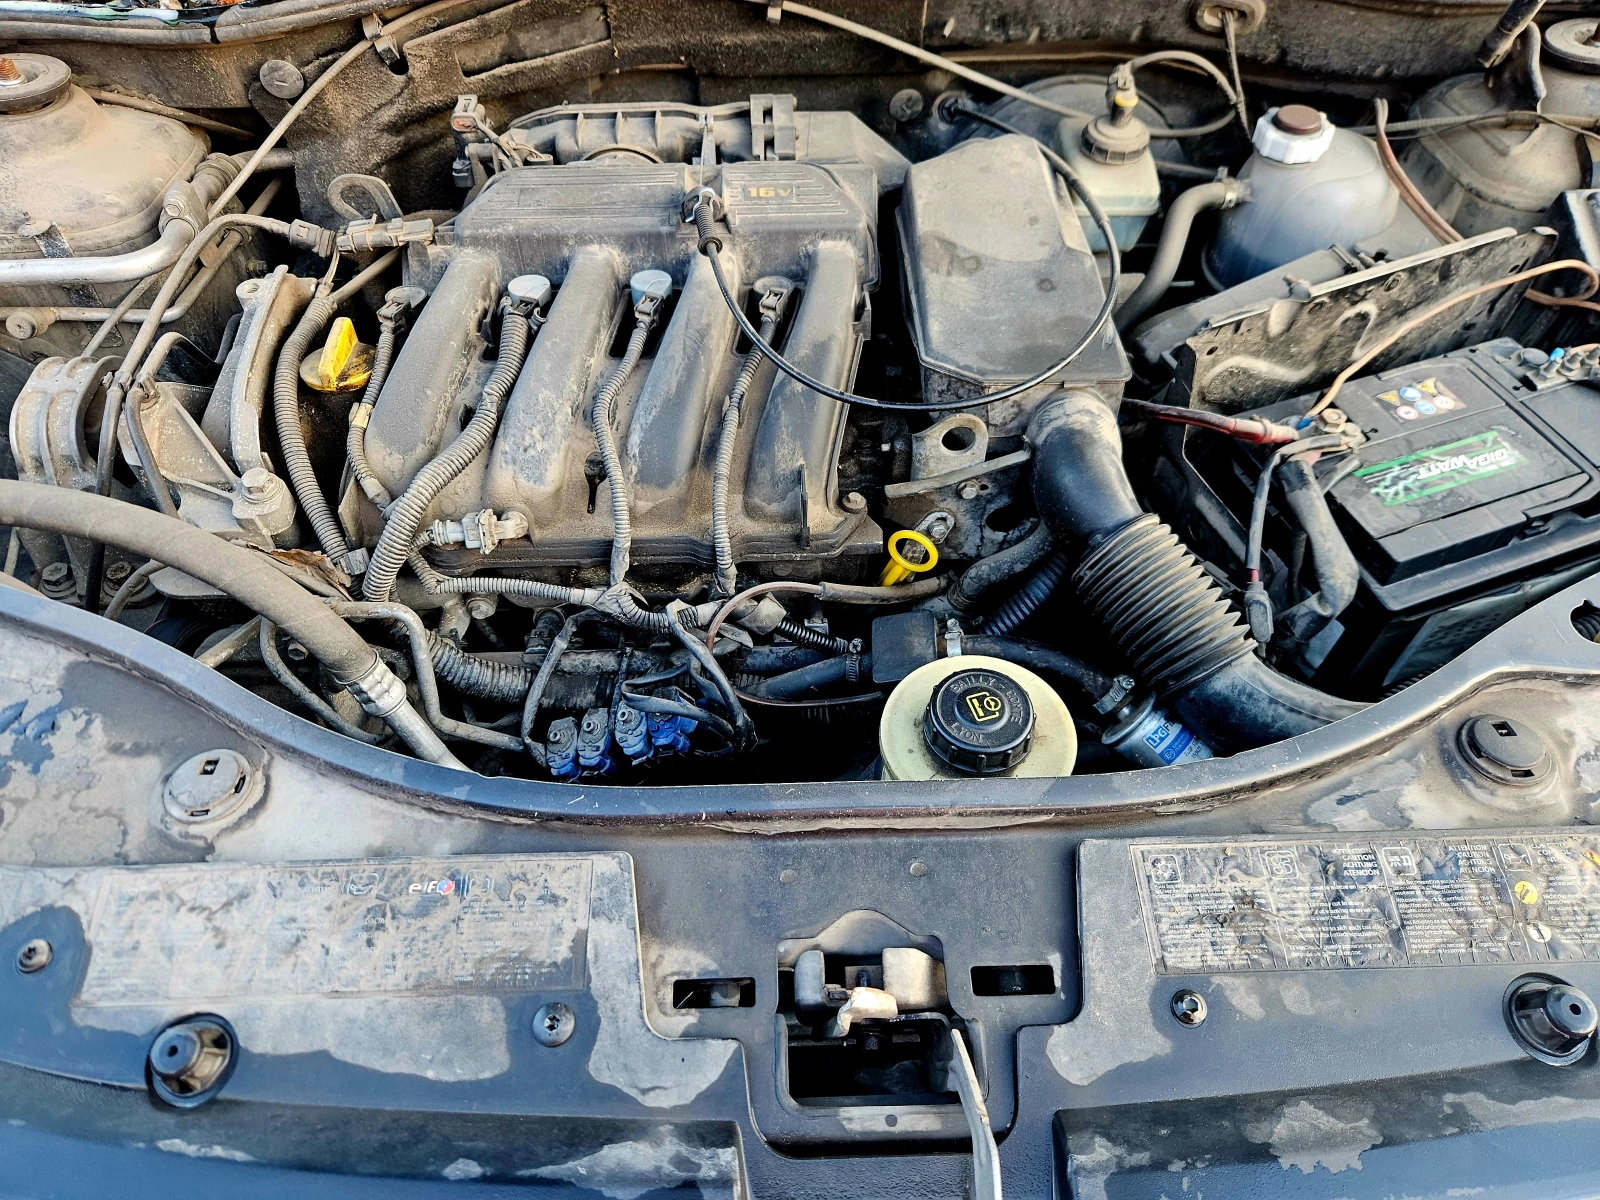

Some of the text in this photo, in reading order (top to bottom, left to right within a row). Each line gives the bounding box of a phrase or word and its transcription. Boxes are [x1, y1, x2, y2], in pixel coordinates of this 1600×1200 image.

[1417, 448, 1509, 480] GIGAWATT
[951, 722, 986, 743] LYON
[1448, 844, 1487, 852] ATTENTION
